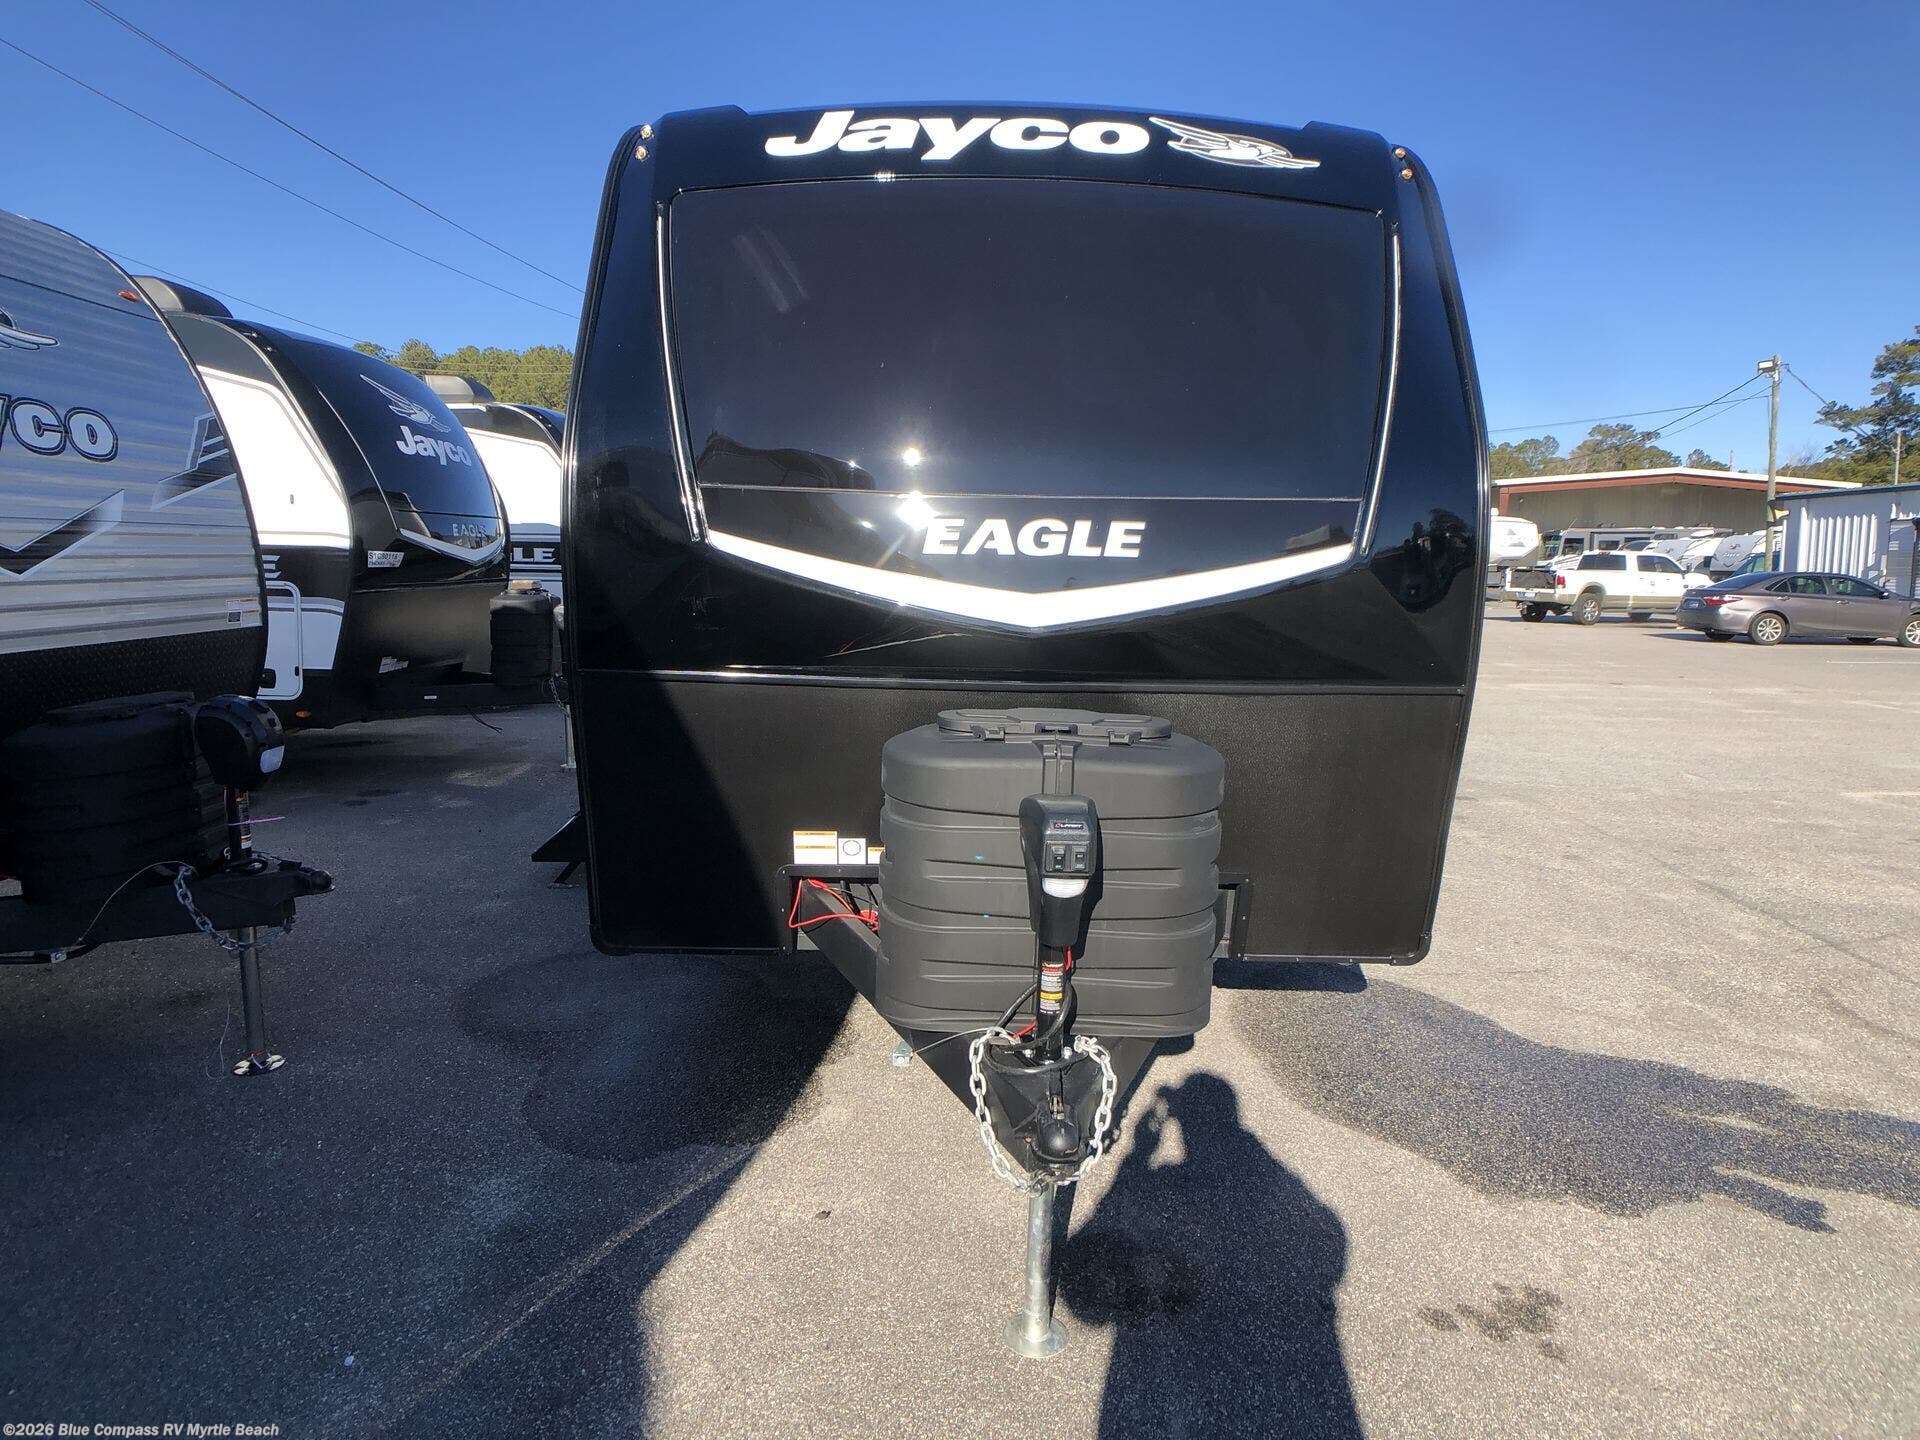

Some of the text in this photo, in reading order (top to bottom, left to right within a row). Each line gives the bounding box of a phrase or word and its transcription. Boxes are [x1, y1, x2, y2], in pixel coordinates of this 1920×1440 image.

[765, 110, 1150, 161] Jayco
[396, 425, 472, 466] Jayco
[452, 523, 487, 537] EAGLE
[922, 517, 1146, 558] EAGLE
